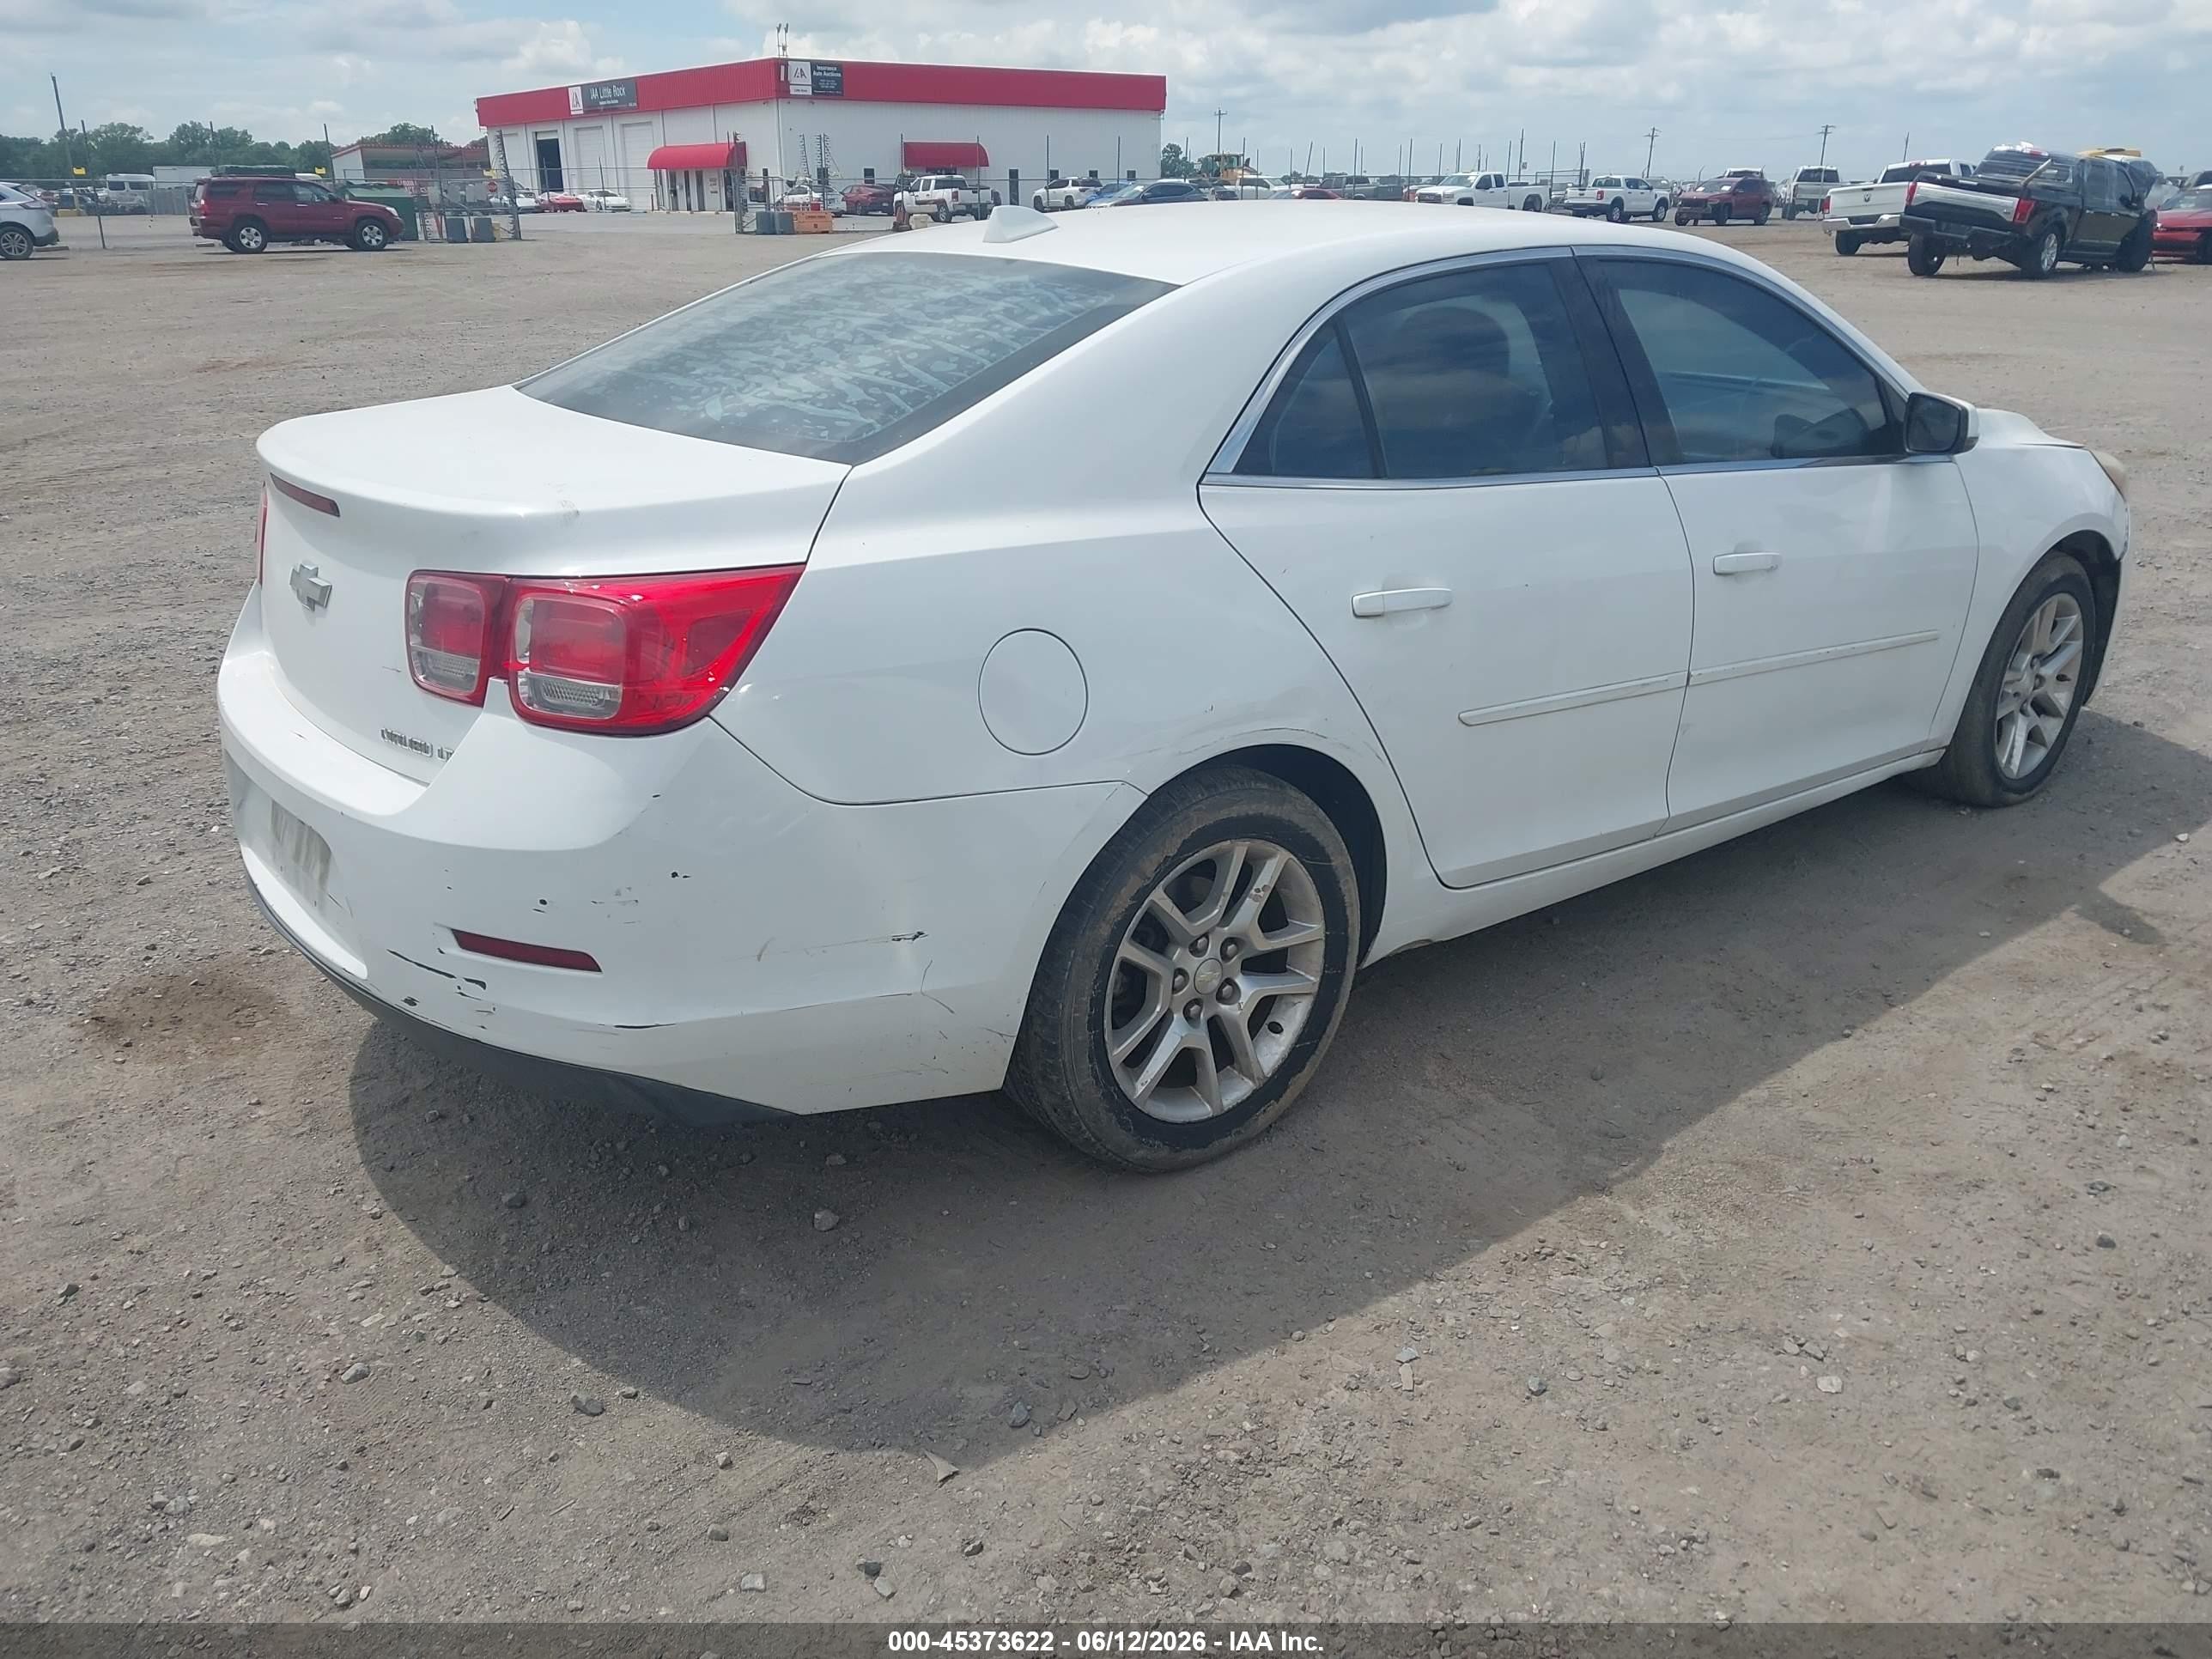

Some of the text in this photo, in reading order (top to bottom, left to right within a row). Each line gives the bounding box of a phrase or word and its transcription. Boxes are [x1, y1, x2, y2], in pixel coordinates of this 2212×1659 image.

[590, 84, 626, 100] IAA Little Rock
